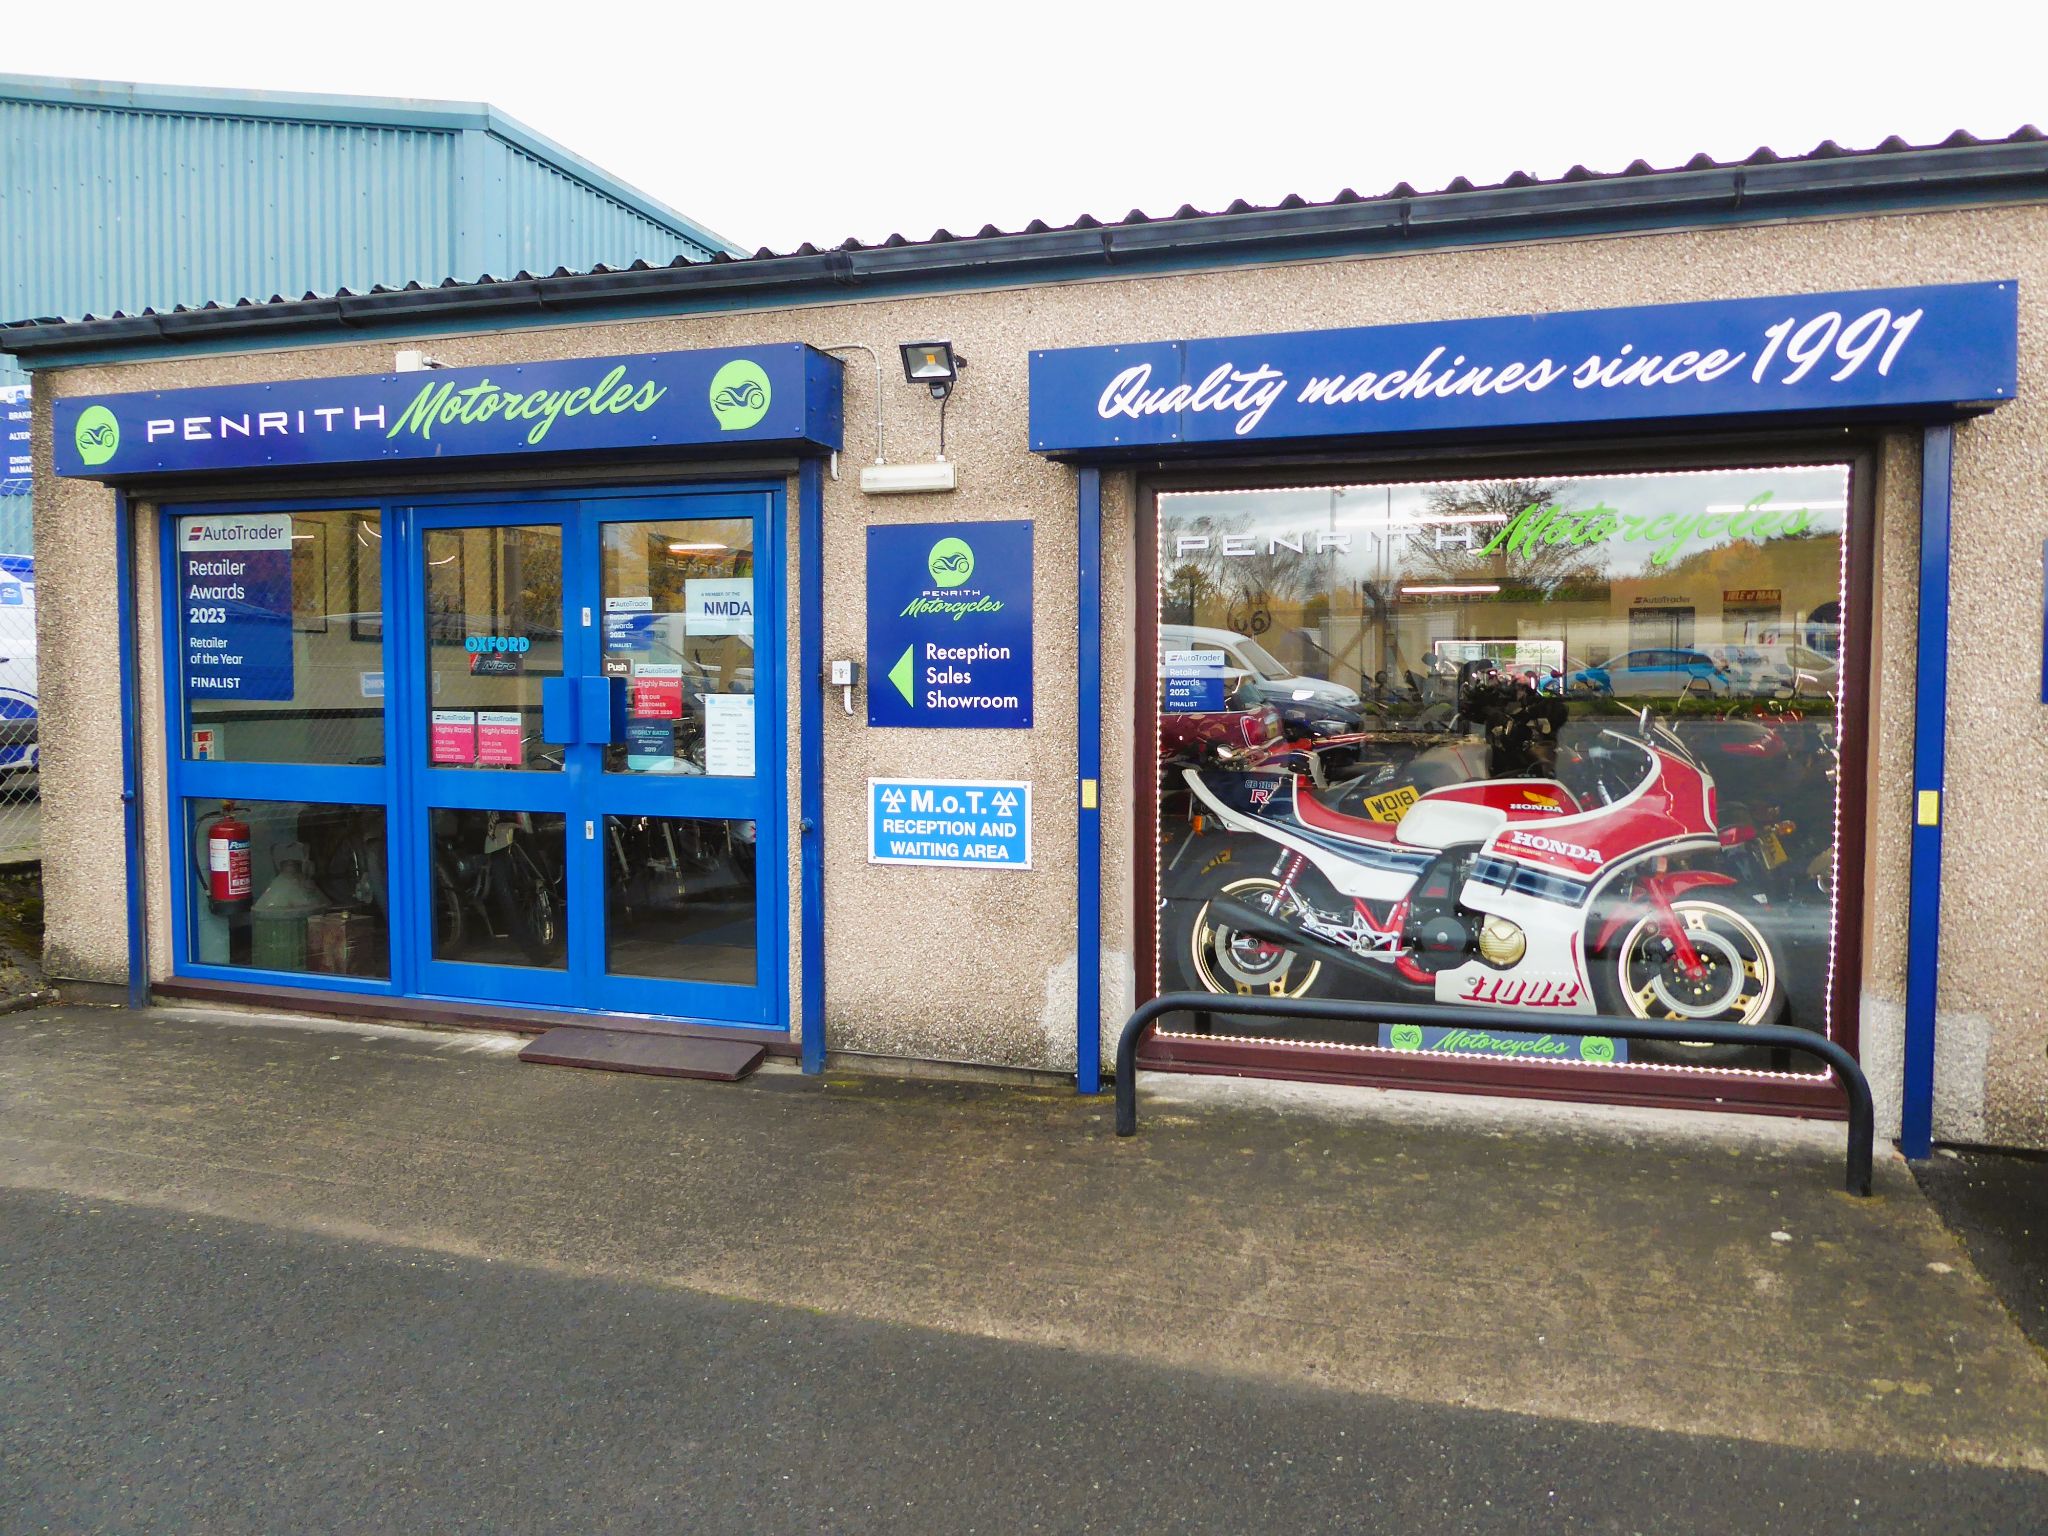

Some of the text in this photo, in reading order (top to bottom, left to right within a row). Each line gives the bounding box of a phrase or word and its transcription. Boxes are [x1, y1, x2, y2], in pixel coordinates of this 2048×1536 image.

[1098, 307, 1924, 435] Quality machines since 1991
[147, 364, 667, 445] PENRITH Motorcycles
[203, 524, 283, 540] AutoTrader
[1176, 490, 1824, 565] PENRITH Motorcycles
[189, 559, 246, 576] Retailer
[189, 582, 245, 600] Awards
[922, 589, 981, 597] PENRITH
[616, 600, 648, 608] AutoTrader
[704, 601, 752, 616] NMDA
[899, 595, 1005, 621] Motorcycles
[189, 607, 227, 624] 2023
[190, 637, 228, 648] Retailer
[464, 636, 531, 653] OXFORD
[190, 653, 243, 665] of the Year
[926, 642, 1011, 665] Reception
[1178, 654, 1220, 662] AutoTrader
[482, 660, 517, 670] Nitro
[607, 662, 628, 672] Push
[1169, 668, 1200, 676] Retailer
[191, 677, 241, 688] FINALIST
[926, 665, 972, 685] Sales
[1169, 678, 1200, 686] Awards
[638, 680, 658, 688] Highly
[926, 689, 1018, 709] Showroom
[1169, 688, 1190, 696] 2023
[435, 726, 453, 734] Highly
[481, 727, 500, 735] Highly
[911, 789, 988, 814] M.o.T.
[1250, 789, 1270, 804] R
[1510, 803, 1564, 813] HONDA
[883, 818, 1017, 837] RECEPTION AND
[890, 840, 1010, 859] WAITING AREA
[1511, 830, 1604, 864] HONDA
[1431, 1029, 1570, 1057] Motorcycles
